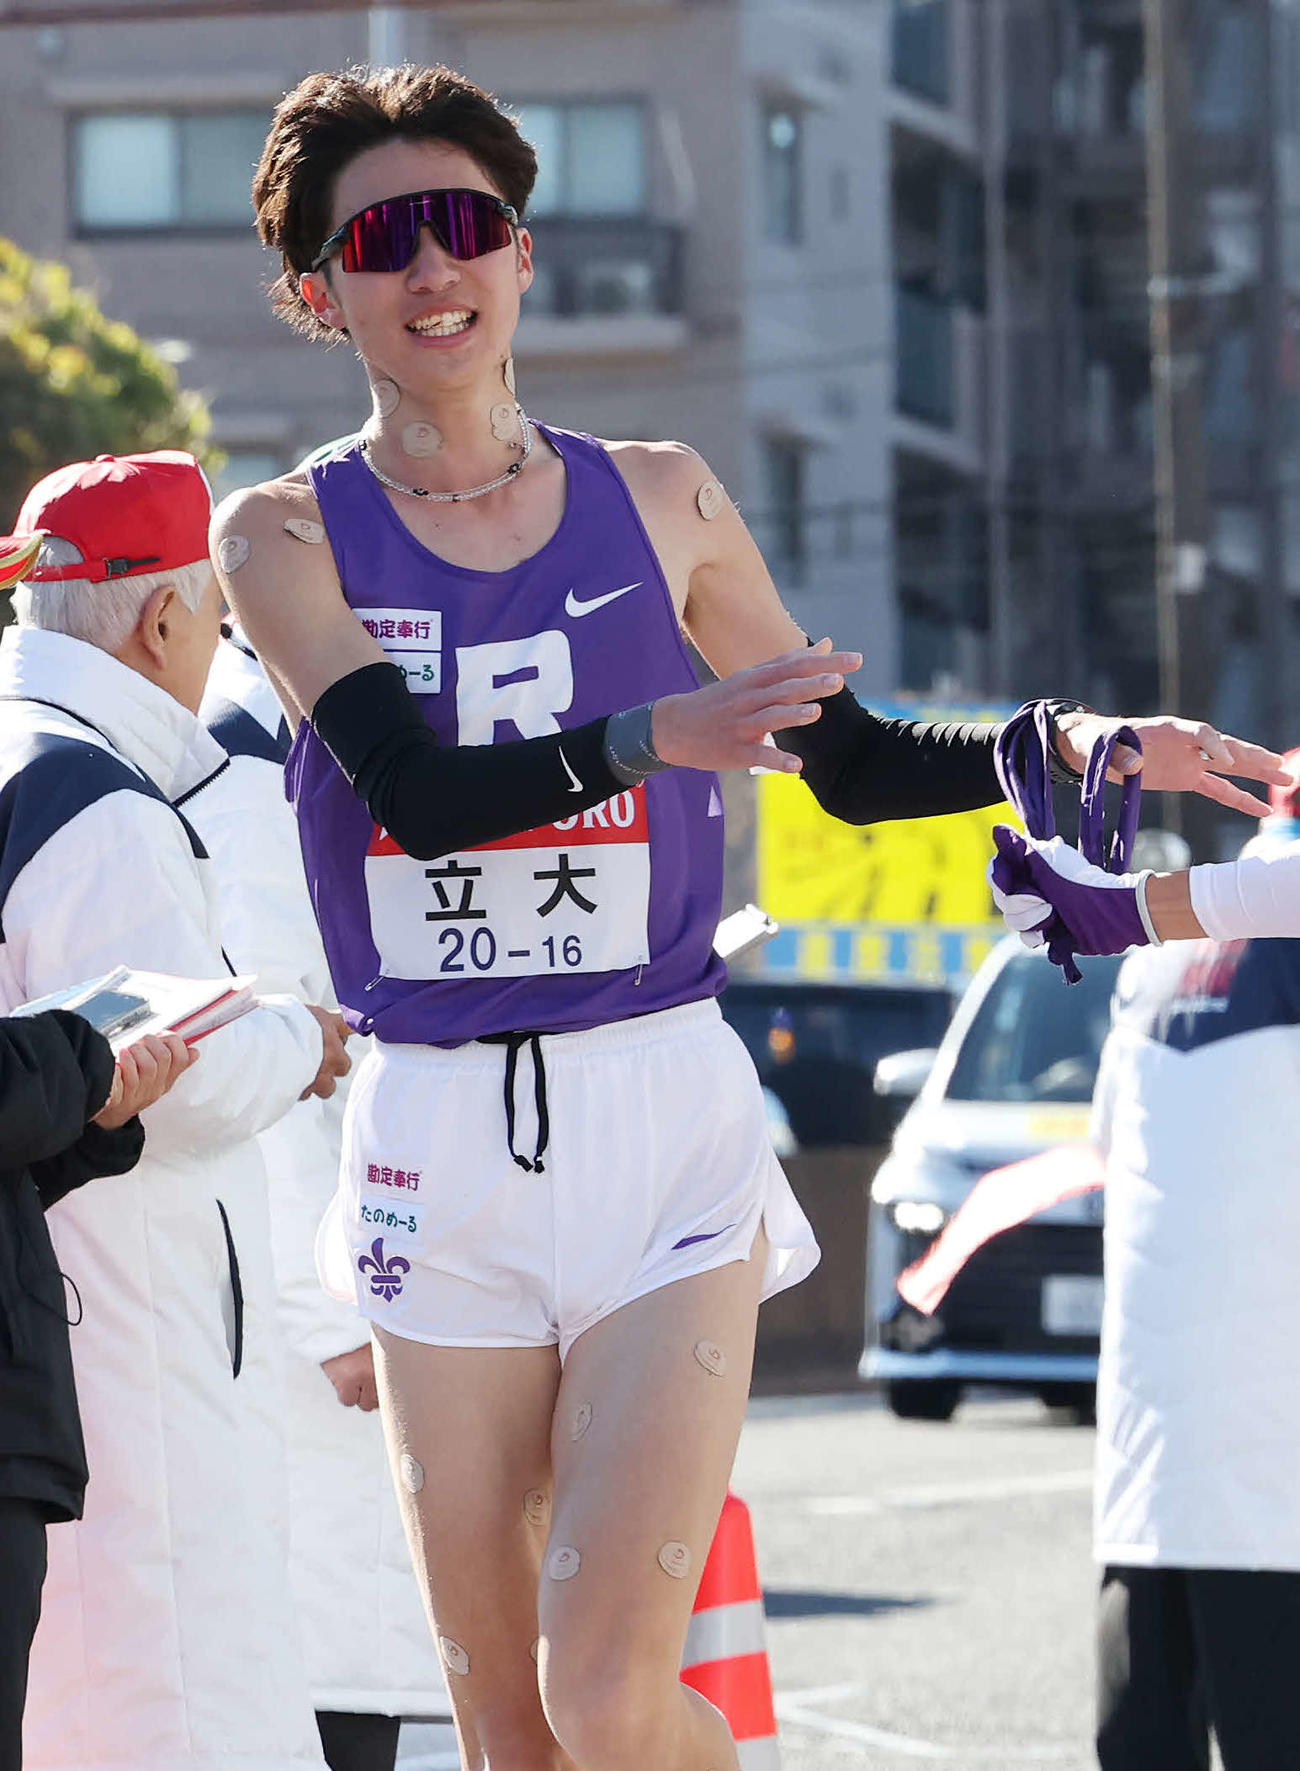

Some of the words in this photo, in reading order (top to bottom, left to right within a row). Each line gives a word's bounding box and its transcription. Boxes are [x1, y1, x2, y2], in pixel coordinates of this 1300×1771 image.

[455, 629, 574, 747] R
[360, 1204, 417, 1233] たのめーる
